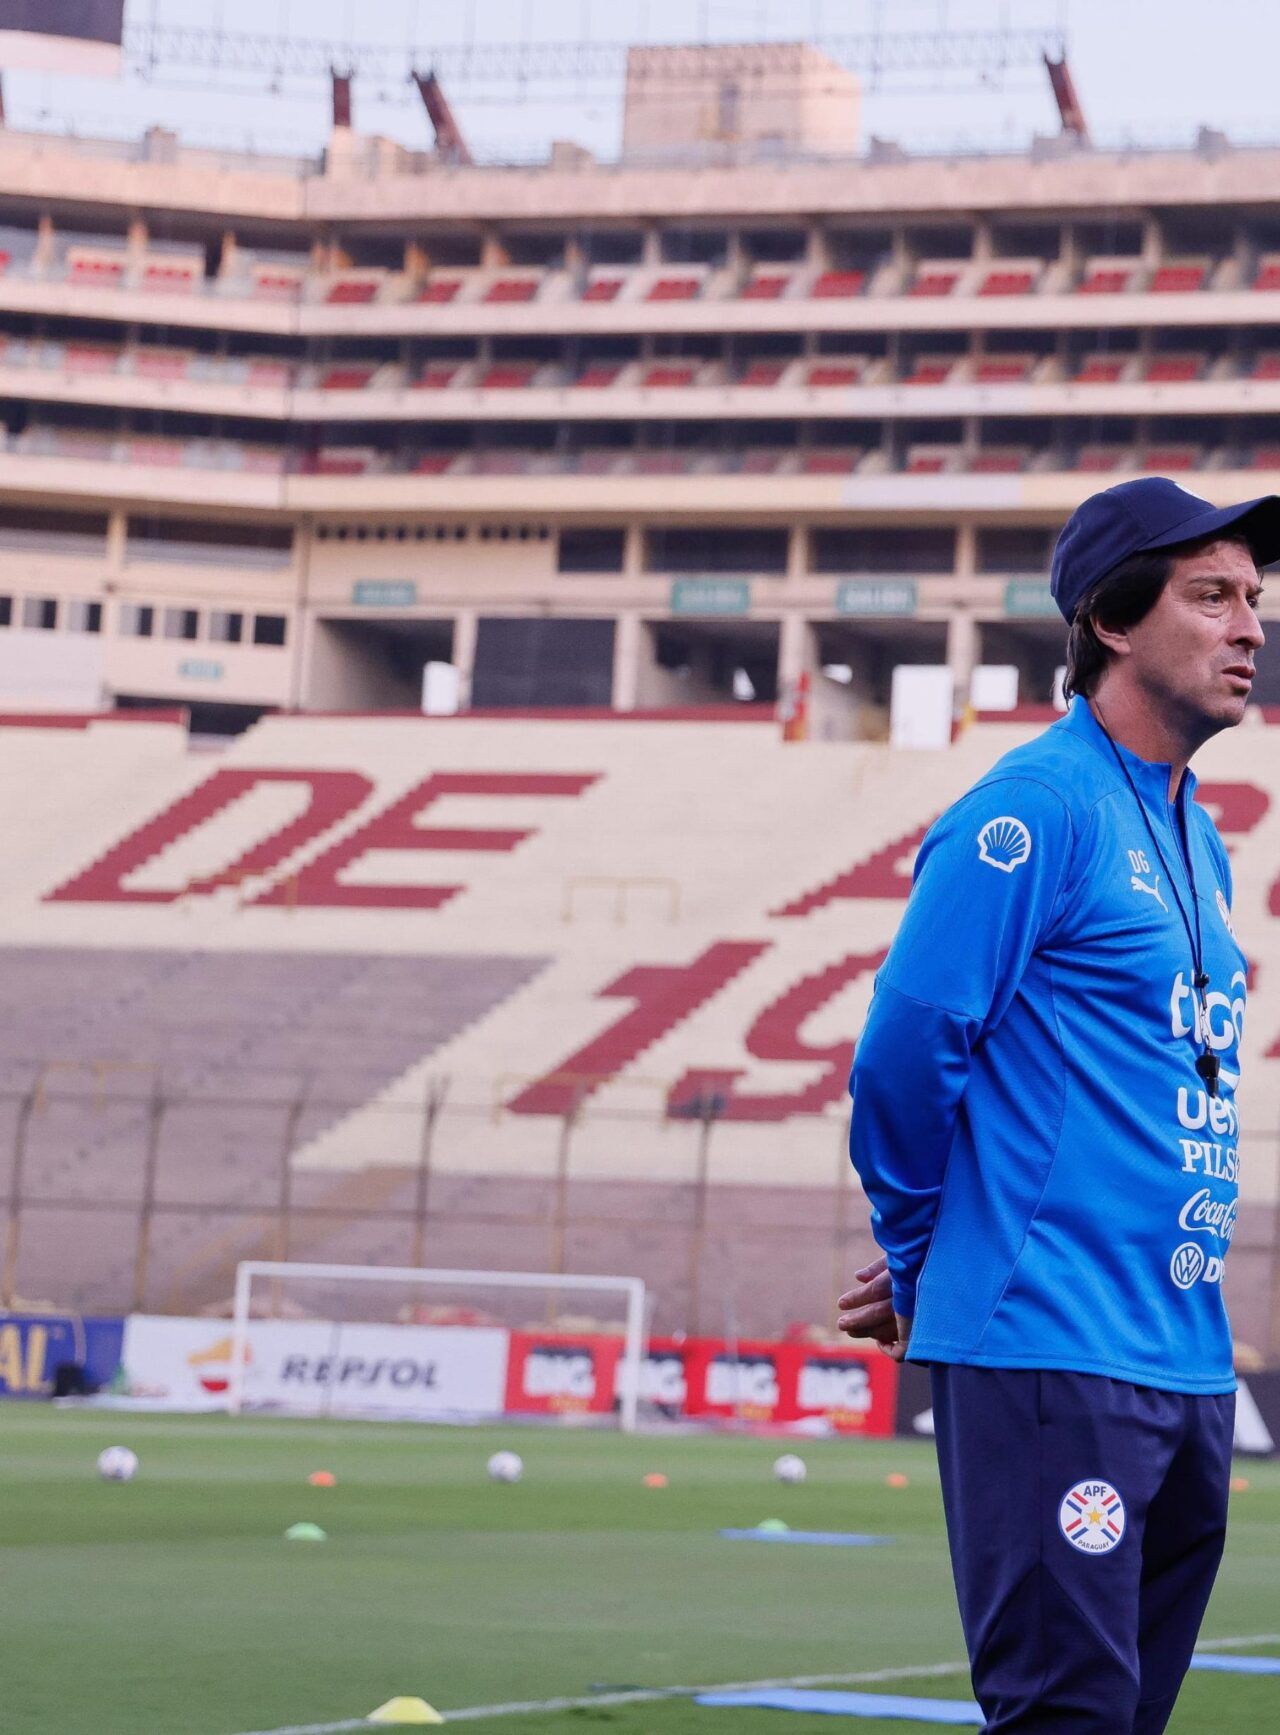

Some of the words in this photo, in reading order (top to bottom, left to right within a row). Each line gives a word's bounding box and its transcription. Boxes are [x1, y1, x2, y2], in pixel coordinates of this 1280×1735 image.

[40, 768, 606, 908] DE
[1128, 849, 1150, 874] DG
[1177, 1086, 1239, 1137] uen
[280, 1353, 439, 1390] REPSOL
[1083, 1485, 1107, 1497] APF
[1077, 1540, 1110, 1550] PARAGUAY
